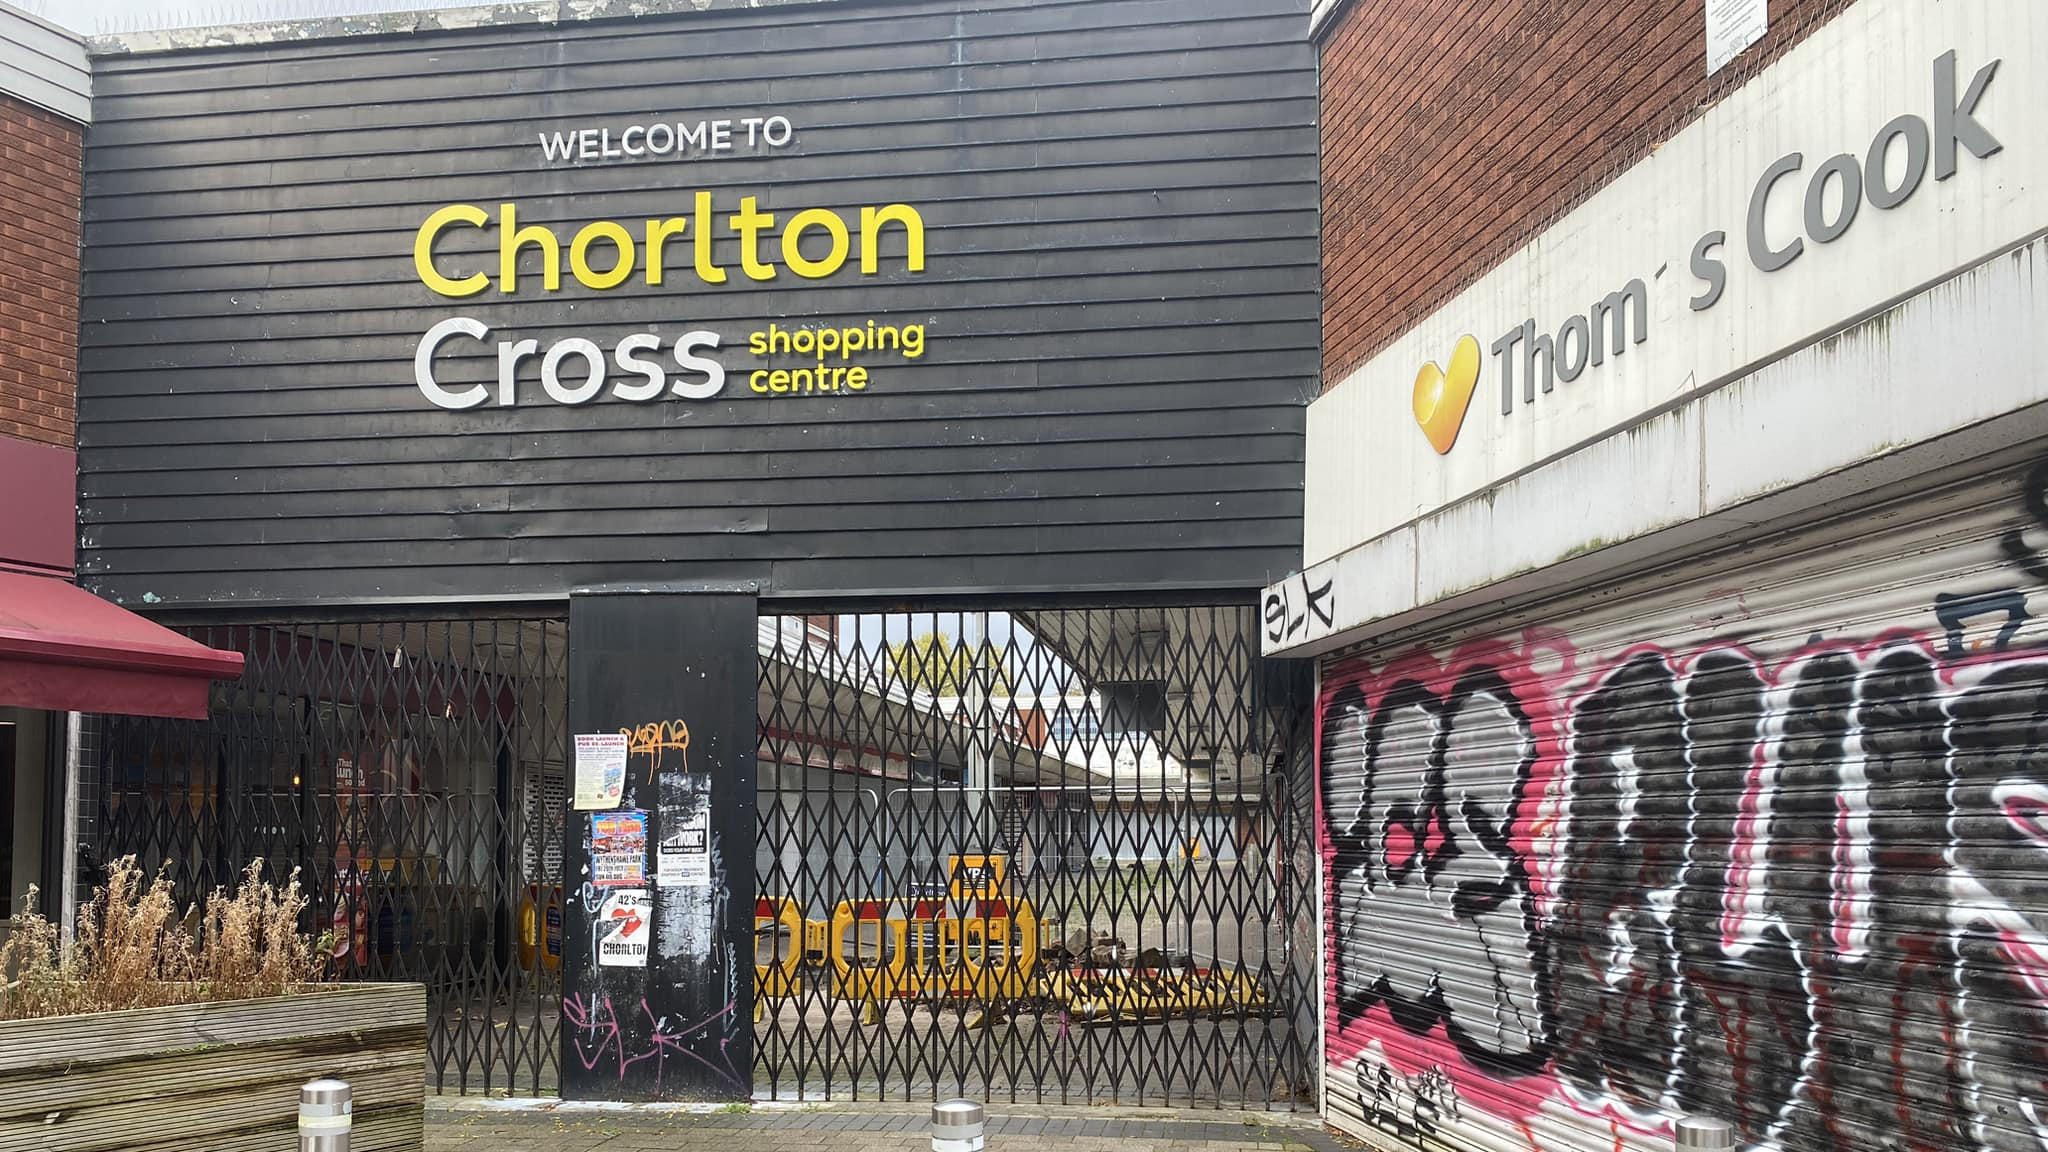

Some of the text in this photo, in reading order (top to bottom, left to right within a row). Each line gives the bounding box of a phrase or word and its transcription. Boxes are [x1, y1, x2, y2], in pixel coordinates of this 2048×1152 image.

[538, 115, 792, 161] WELCOME TO
[414, 190, 926, 297] Chorlton
[1491, 48, 2004, 417] Thoms Cook
[749, 319, 926, 359] shopping
[414, 316, 726, 411] Cross
[749, 361, 869, 394] centre
[336, 763, 364, 780] lunh
[617, 894, 637, 906] 42's
